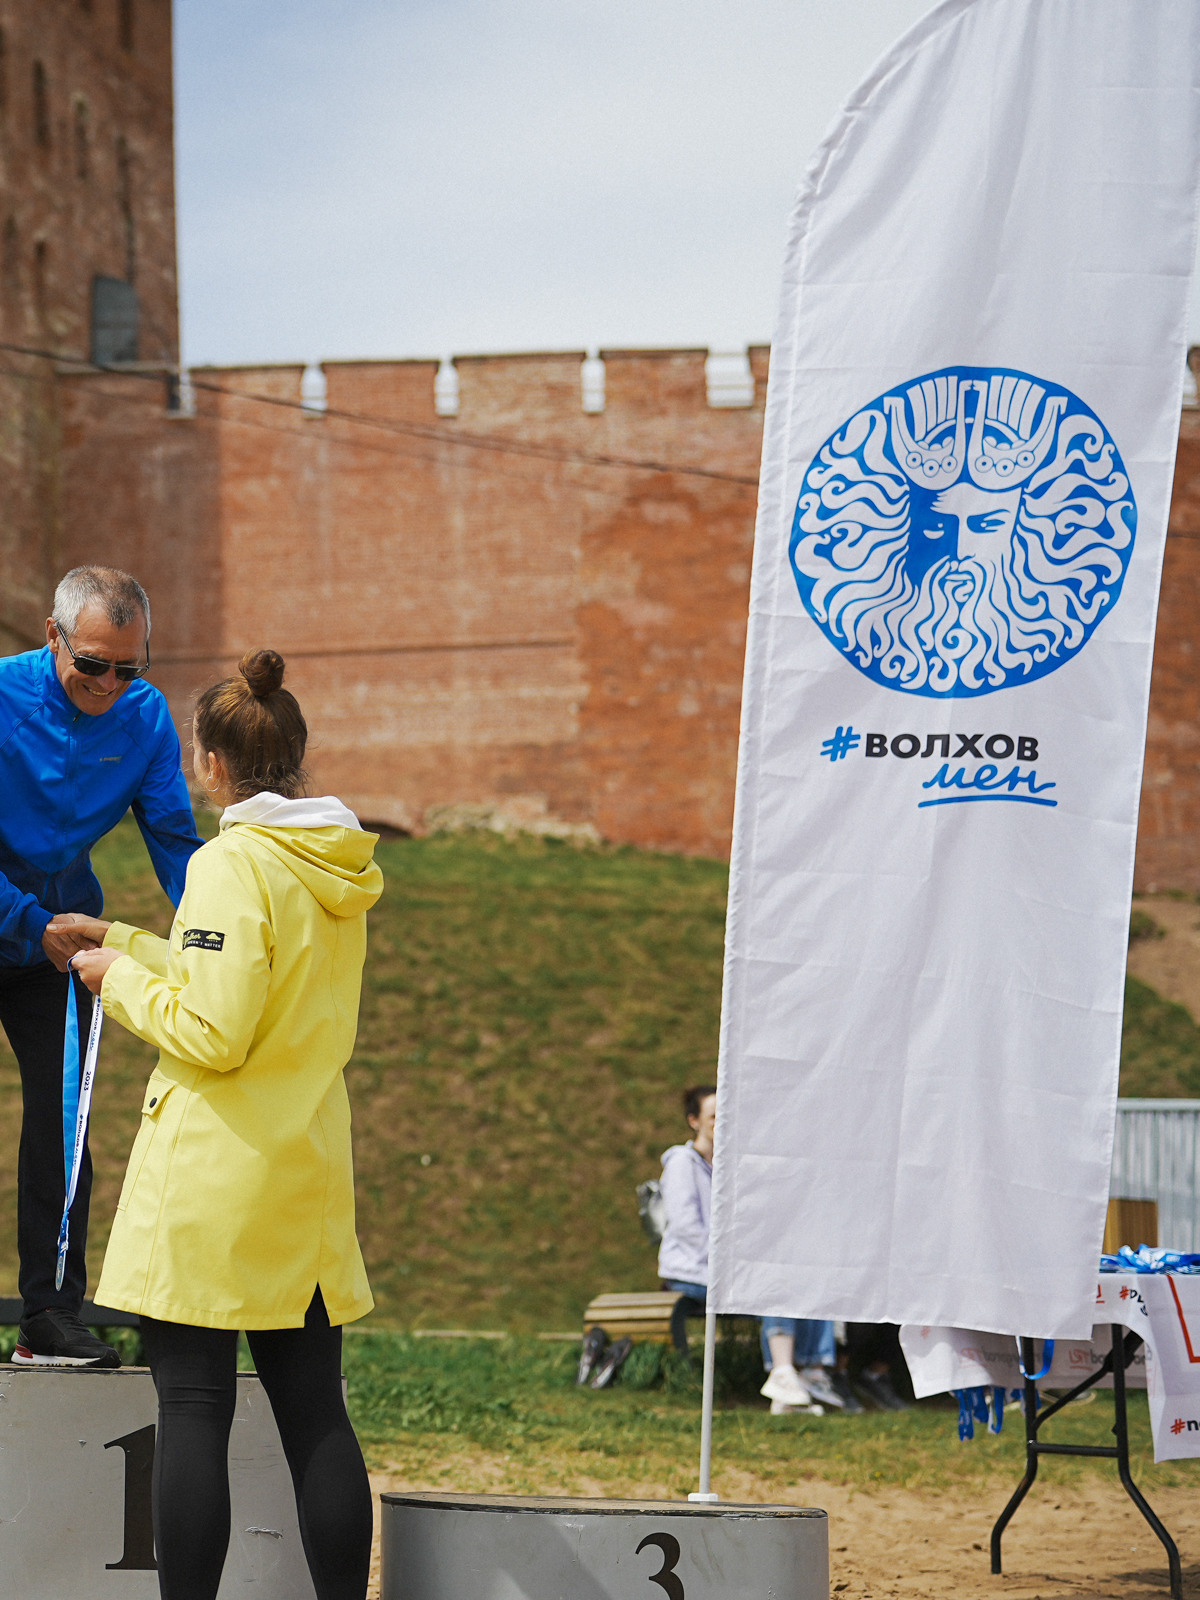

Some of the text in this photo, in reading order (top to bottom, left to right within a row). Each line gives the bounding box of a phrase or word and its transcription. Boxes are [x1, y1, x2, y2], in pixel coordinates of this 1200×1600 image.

[820, 726, 1040, 762] #ВОЛХОВ
[83, 1071, 91, 1091] 2023
[104, 1424, 158, 1570] 1
[635, 1532, 686, 1600] 3
